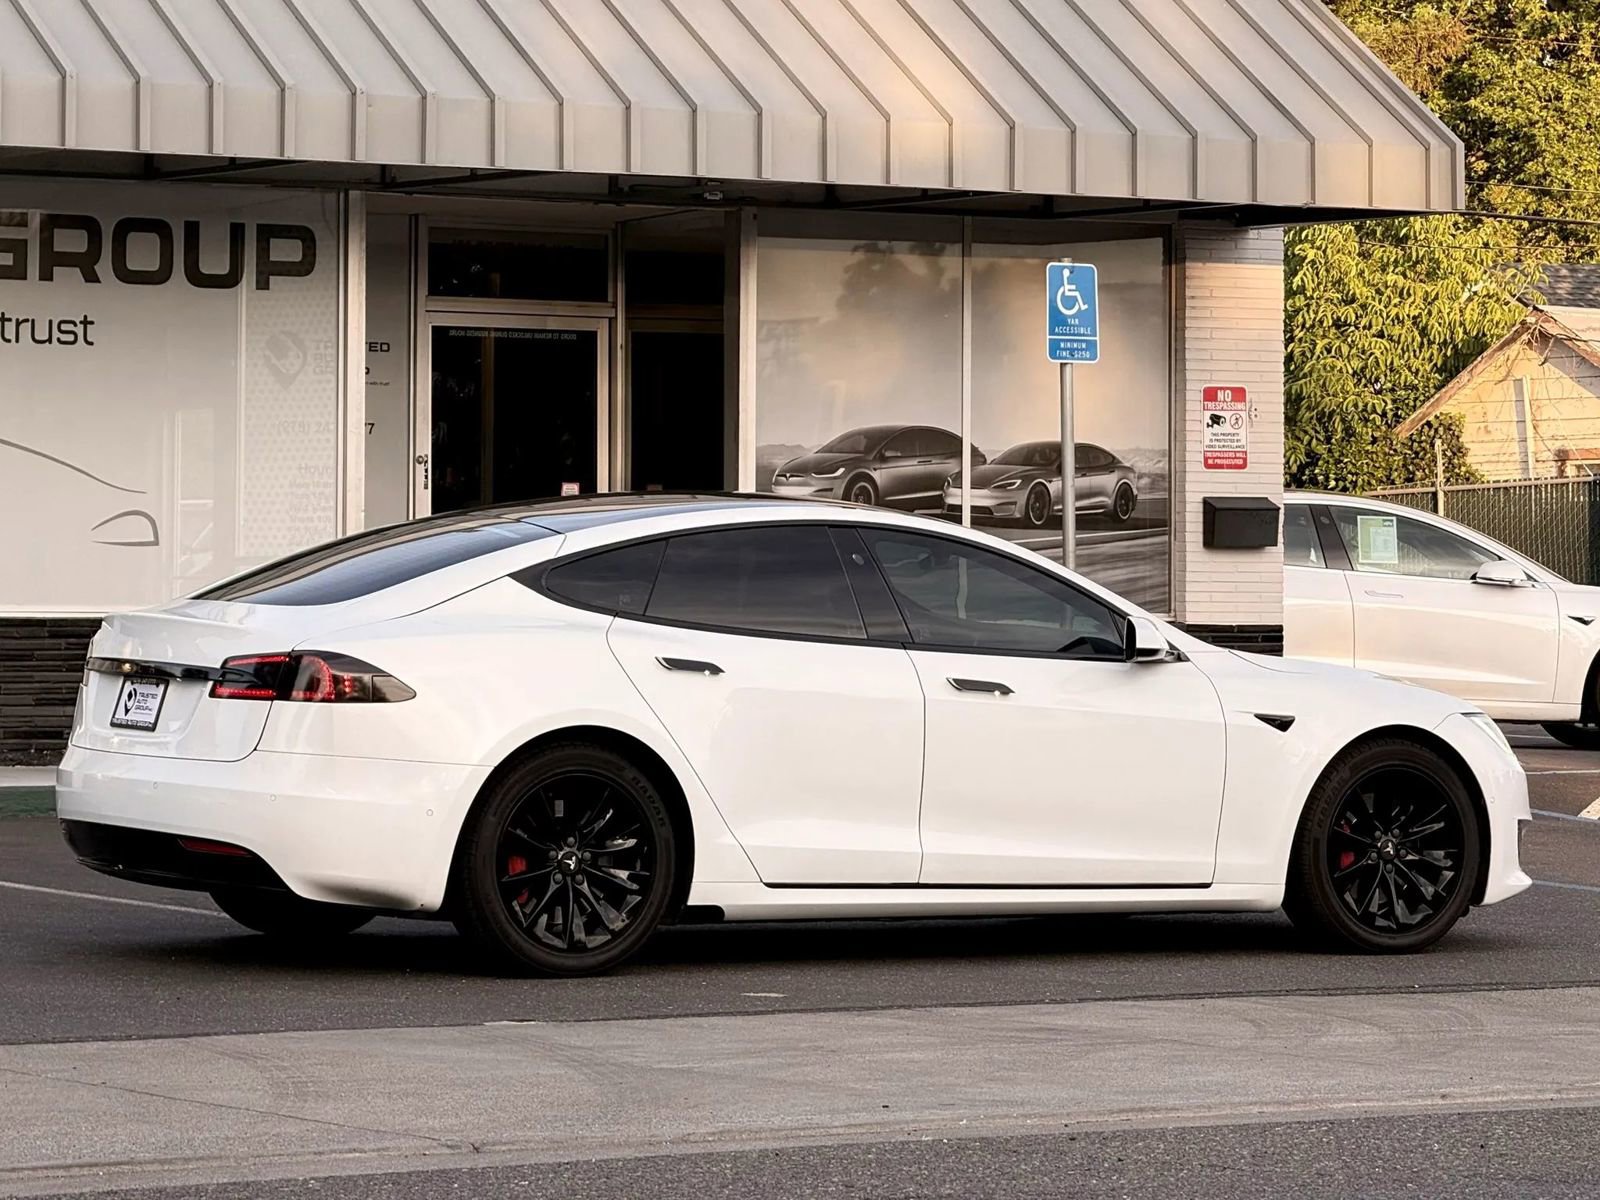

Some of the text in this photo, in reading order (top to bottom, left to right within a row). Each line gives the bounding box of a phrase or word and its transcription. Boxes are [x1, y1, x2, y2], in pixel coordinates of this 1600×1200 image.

[0, 312, 95, 346] trust
[1054, 326, 1092, 334] ACCESSIBLE
[365, 341, 391, 352] ED
[1060, 341, 1087, 349] MINIMUM
[1056, 350, 1070, 358] FINE
[1217, 389, 1232, 402] NO
[1203, 401, 1246, 410] TRESPASSING
